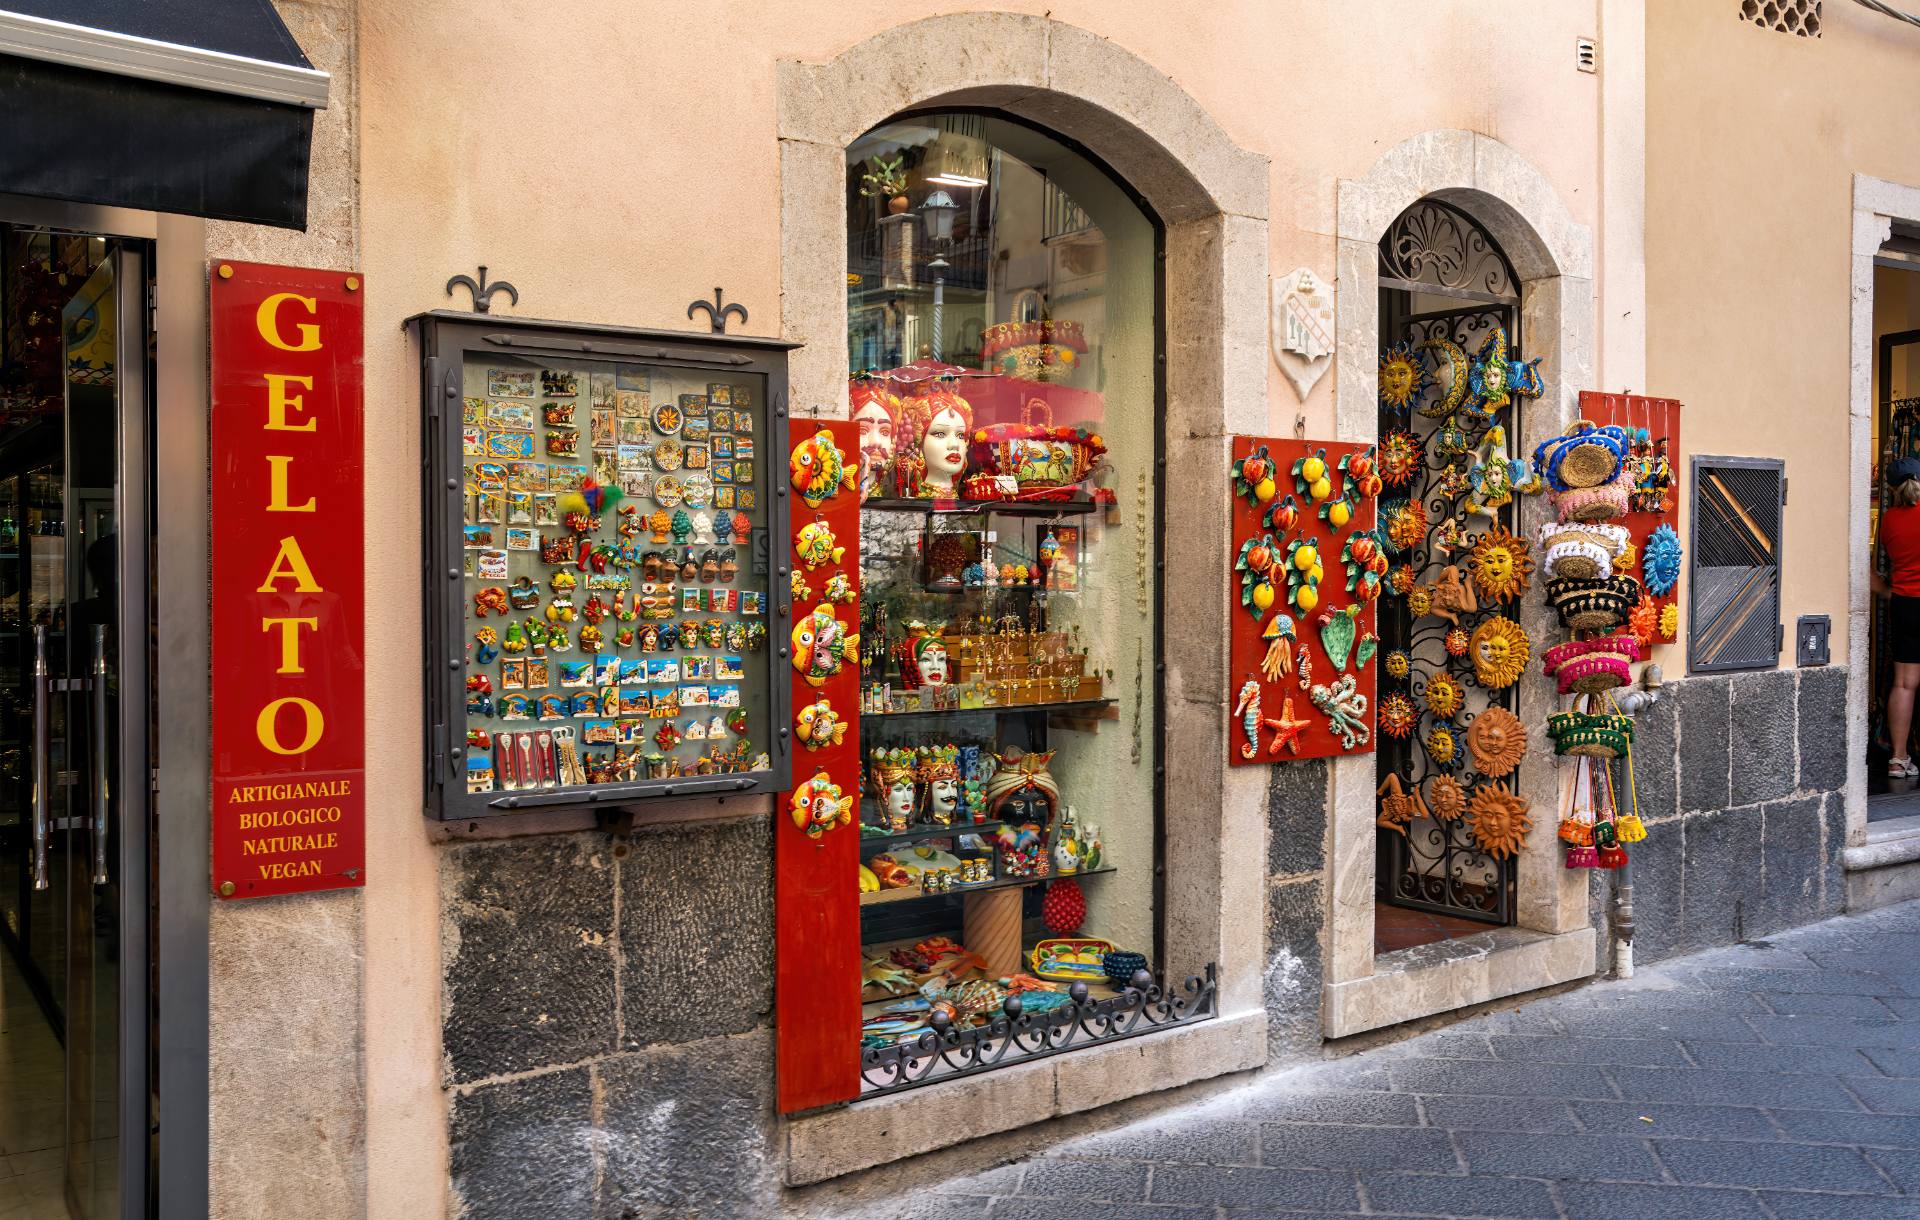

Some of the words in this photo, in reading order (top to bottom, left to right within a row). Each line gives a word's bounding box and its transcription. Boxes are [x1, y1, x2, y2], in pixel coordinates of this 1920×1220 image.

[255, 292, 325, 755] GELATO
[229, 780, 351, 804] ARTIGIANALE
[239, 806, 341, 830] BIOLOGICO
[243, 832, 338, 856] NATURALE
[259, 859, 322, 880] VEGAN
